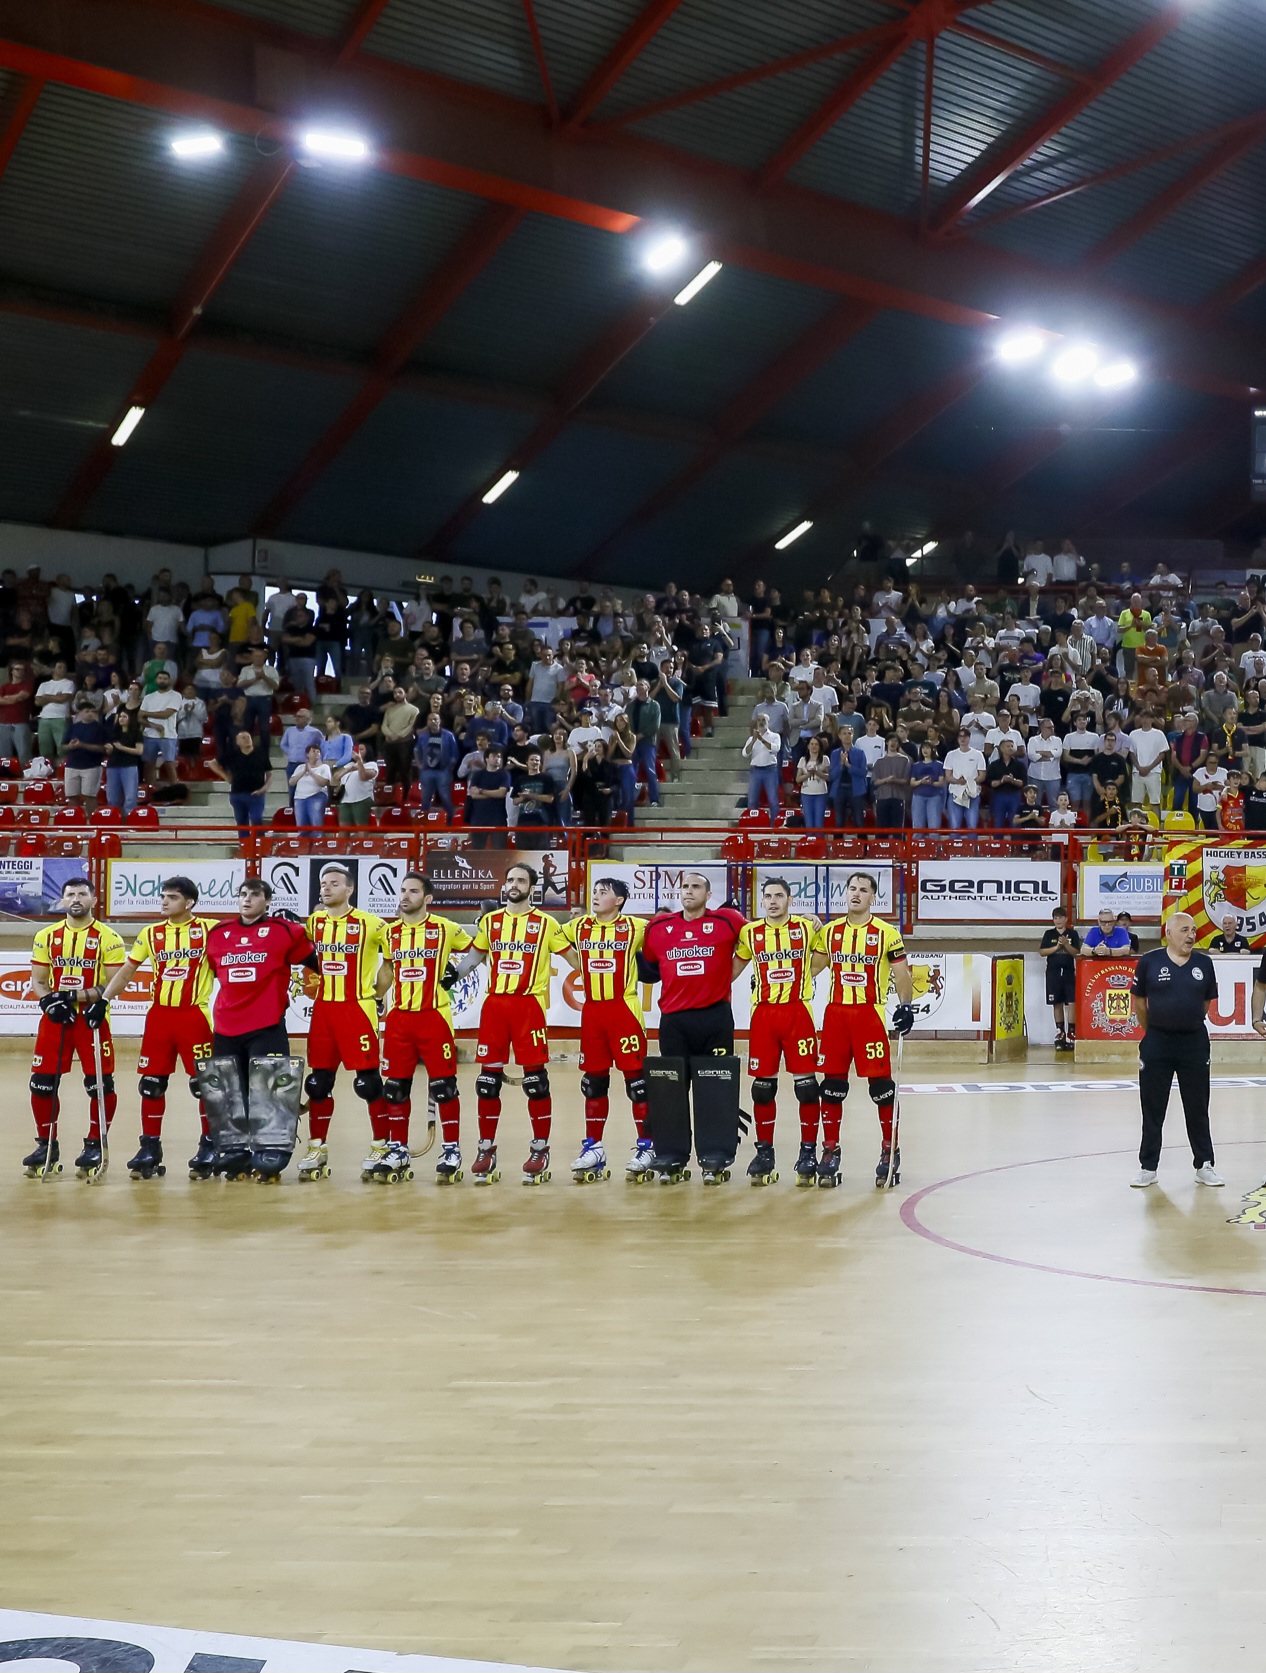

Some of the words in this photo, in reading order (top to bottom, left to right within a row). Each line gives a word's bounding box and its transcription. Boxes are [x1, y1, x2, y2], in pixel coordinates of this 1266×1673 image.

[1206, 851, 1241, 859] HOCKEY
[0, 861, 32, 870] NTEGGI
[1172, 865, 1181, 875] T
[433, 870, 494, 878] ELLENIKA
[634, 870, 685, 890] SPM
[480, 882, 494, 890] Sport
[1116, 878, 1164, 892] GIUBIL
[1172, 879, 1178, 888] F
[490, 939, 538, 953] ubroker
[579, 939, 629, 950] ubroker
[221, 952, 267, 966] ubroker
[666, 945, 714, 961] ubroker
[755, 949, 805, 962] ubroker
[831, 952, 878, 965] ubroker
[1100, 965, 1127, 976] BASSANO
[360, 1035, 370, 1052] 5
[530, 1029, 547, 1046] 14
[620, 1034, 640, 1054] 29
[192, 1043, 212, 1060] 55
[442, 1043, 452, 1060] 8
[798, 1037, 814, 1056] 87
[866, 1041, 884, 1060] 58
